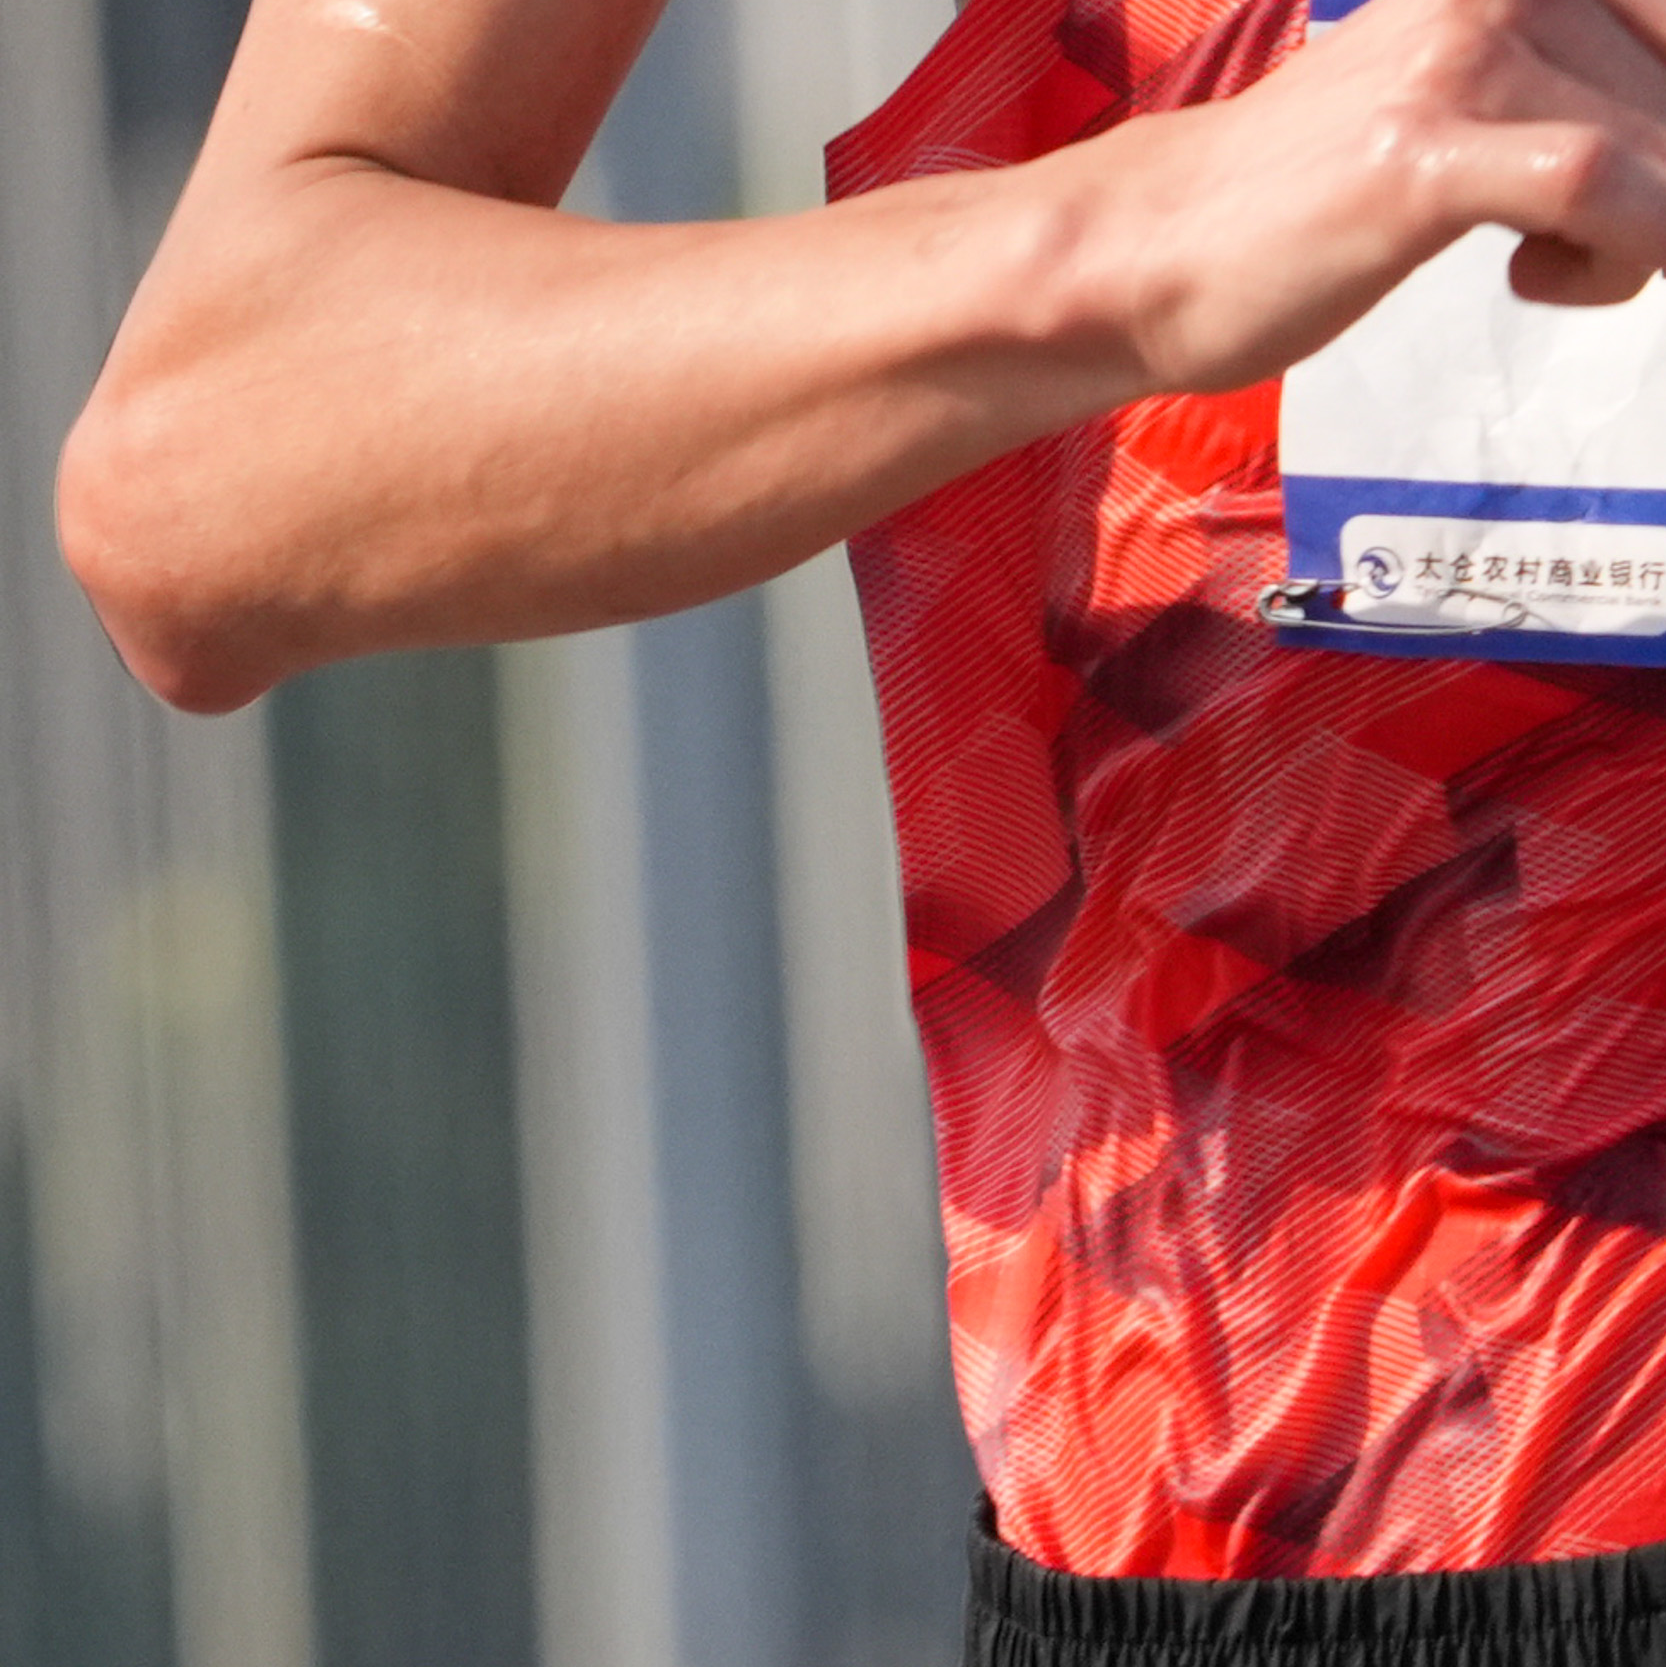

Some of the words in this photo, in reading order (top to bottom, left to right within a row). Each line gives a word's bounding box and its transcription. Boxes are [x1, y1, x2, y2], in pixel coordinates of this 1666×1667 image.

[1413, 551, 1666, 590] 太仓农村商业银行
